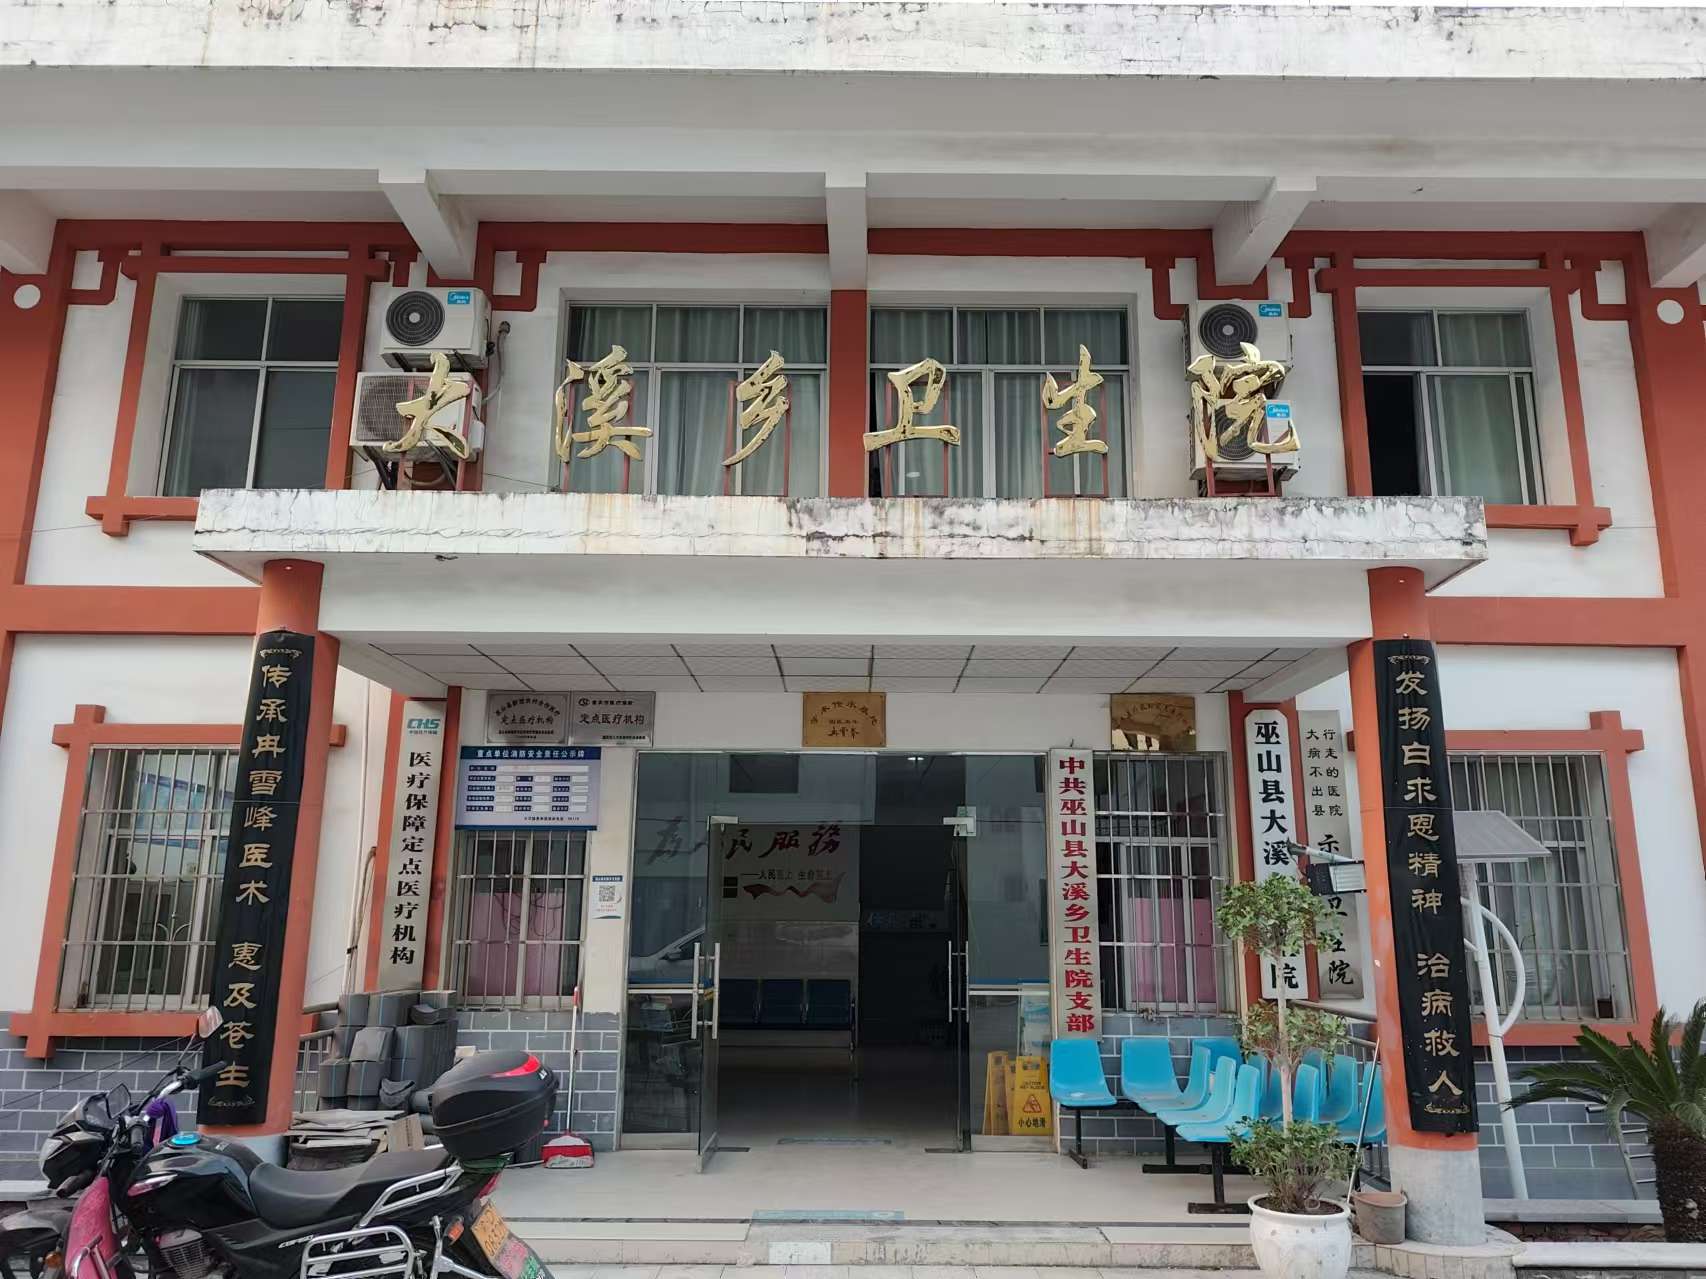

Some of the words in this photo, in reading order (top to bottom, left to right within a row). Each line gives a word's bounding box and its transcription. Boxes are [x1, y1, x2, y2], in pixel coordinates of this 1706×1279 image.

[382, 342, 1300, 466] 大溪乡卫生院
[235, 664, 292, 905] 传承冉雪峰医术
[579, 713, 645, 725] 定点医疗机构
[1306, 729, 1326, 817] 大病不出县
[1322, 729, 1344, 817] 行走的医院
[1395, 670, 1443, 915] 发扬白求恩精神
[390, 751, 432, 965] 医疗保障定点医疗机构
[1059, 756, 1095, 1033] 中共巫山县大溪乡卫生院支部
[1254, 720, 1300, 989] 巫山县大溪院
[215, 941, 263, 1088] 惠及苍生
[1417, 952, 1464, 1096] 治病救人
